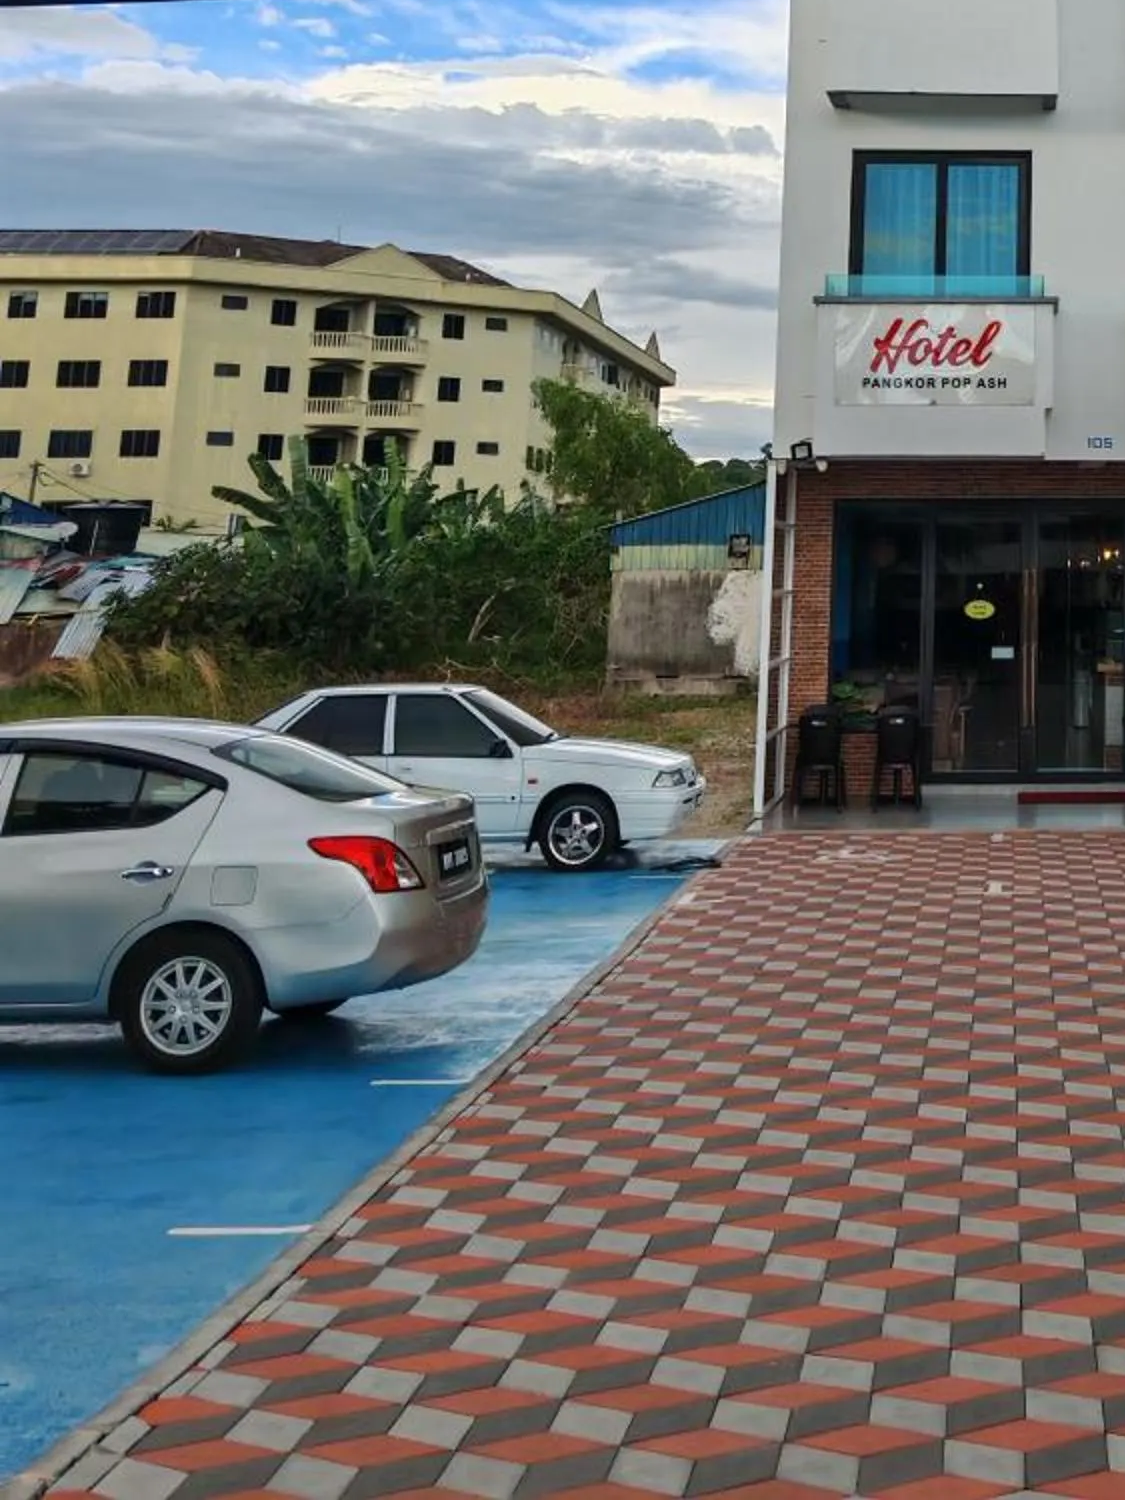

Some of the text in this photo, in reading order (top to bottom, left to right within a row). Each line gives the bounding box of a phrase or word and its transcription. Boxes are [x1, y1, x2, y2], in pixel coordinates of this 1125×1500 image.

[870, 318, 1002, 374] Hotel
[862, 377, 1007, 389] PANGKOR POP ASH
